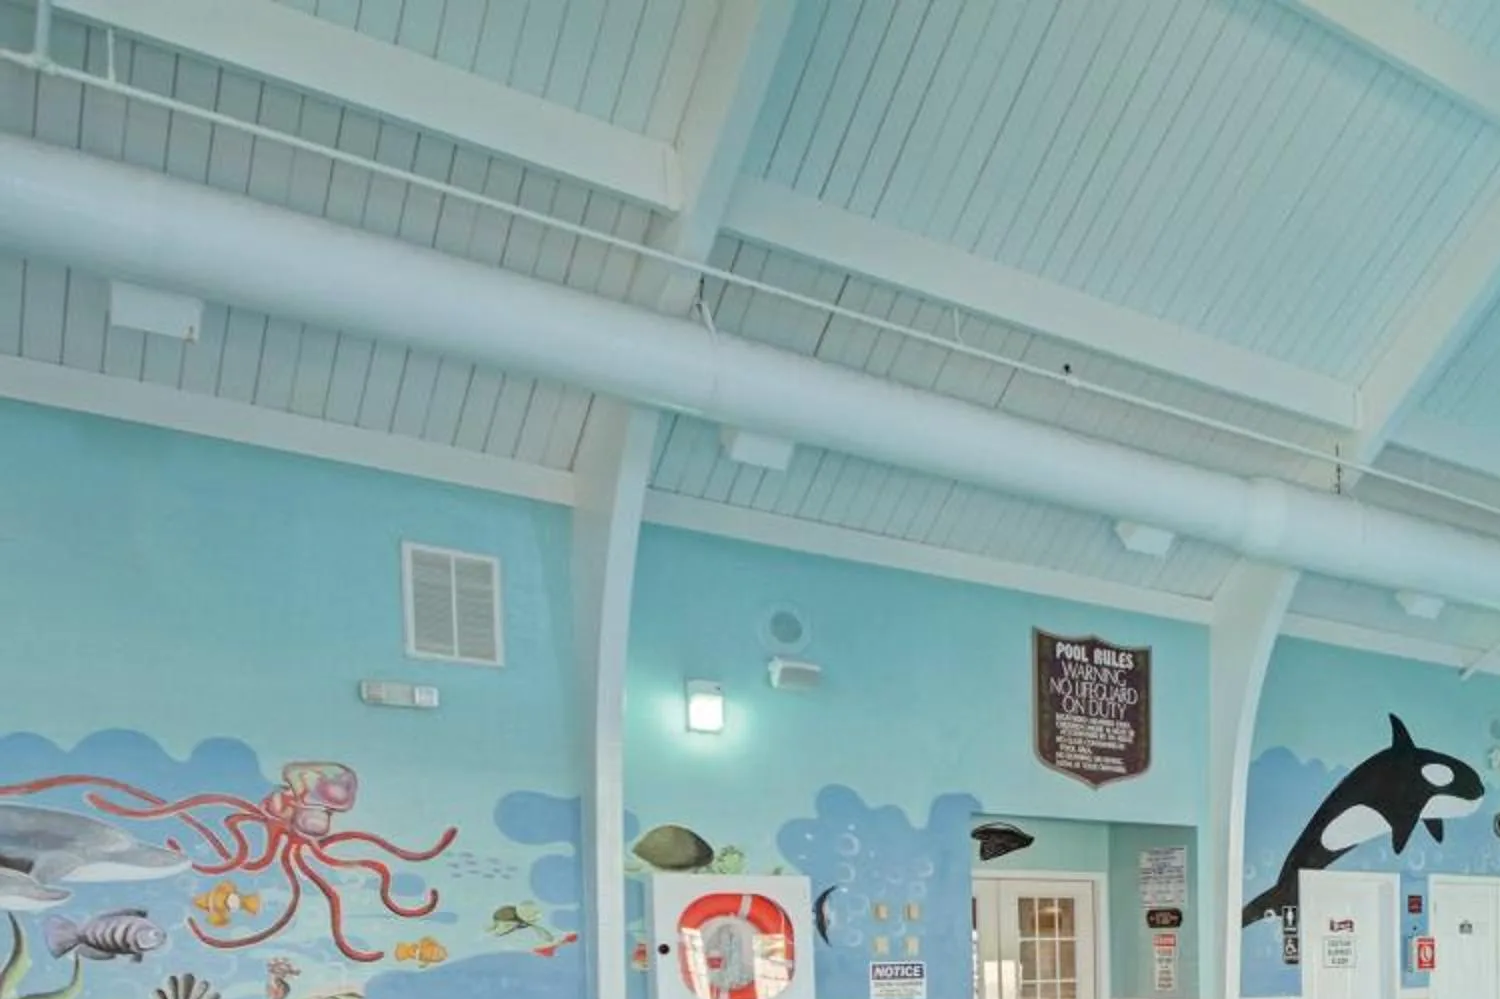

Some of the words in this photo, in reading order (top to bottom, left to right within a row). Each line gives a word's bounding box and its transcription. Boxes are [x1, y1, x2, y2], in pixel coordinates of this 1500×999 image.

[1056, 641, 1089, 662] POOL
[1093, 648, 1134, 670] RULES
[1061, 660, 1127, 686] WARNING
[1049, 677, 1072, 697] NO
[1075, 681, 1138, 705] LIFEGUARD
[1062, 695, 1085, 714] ON
[1089, 700, 1126, 720] DUTY
[874, 965, 921, 978] NOTICE
